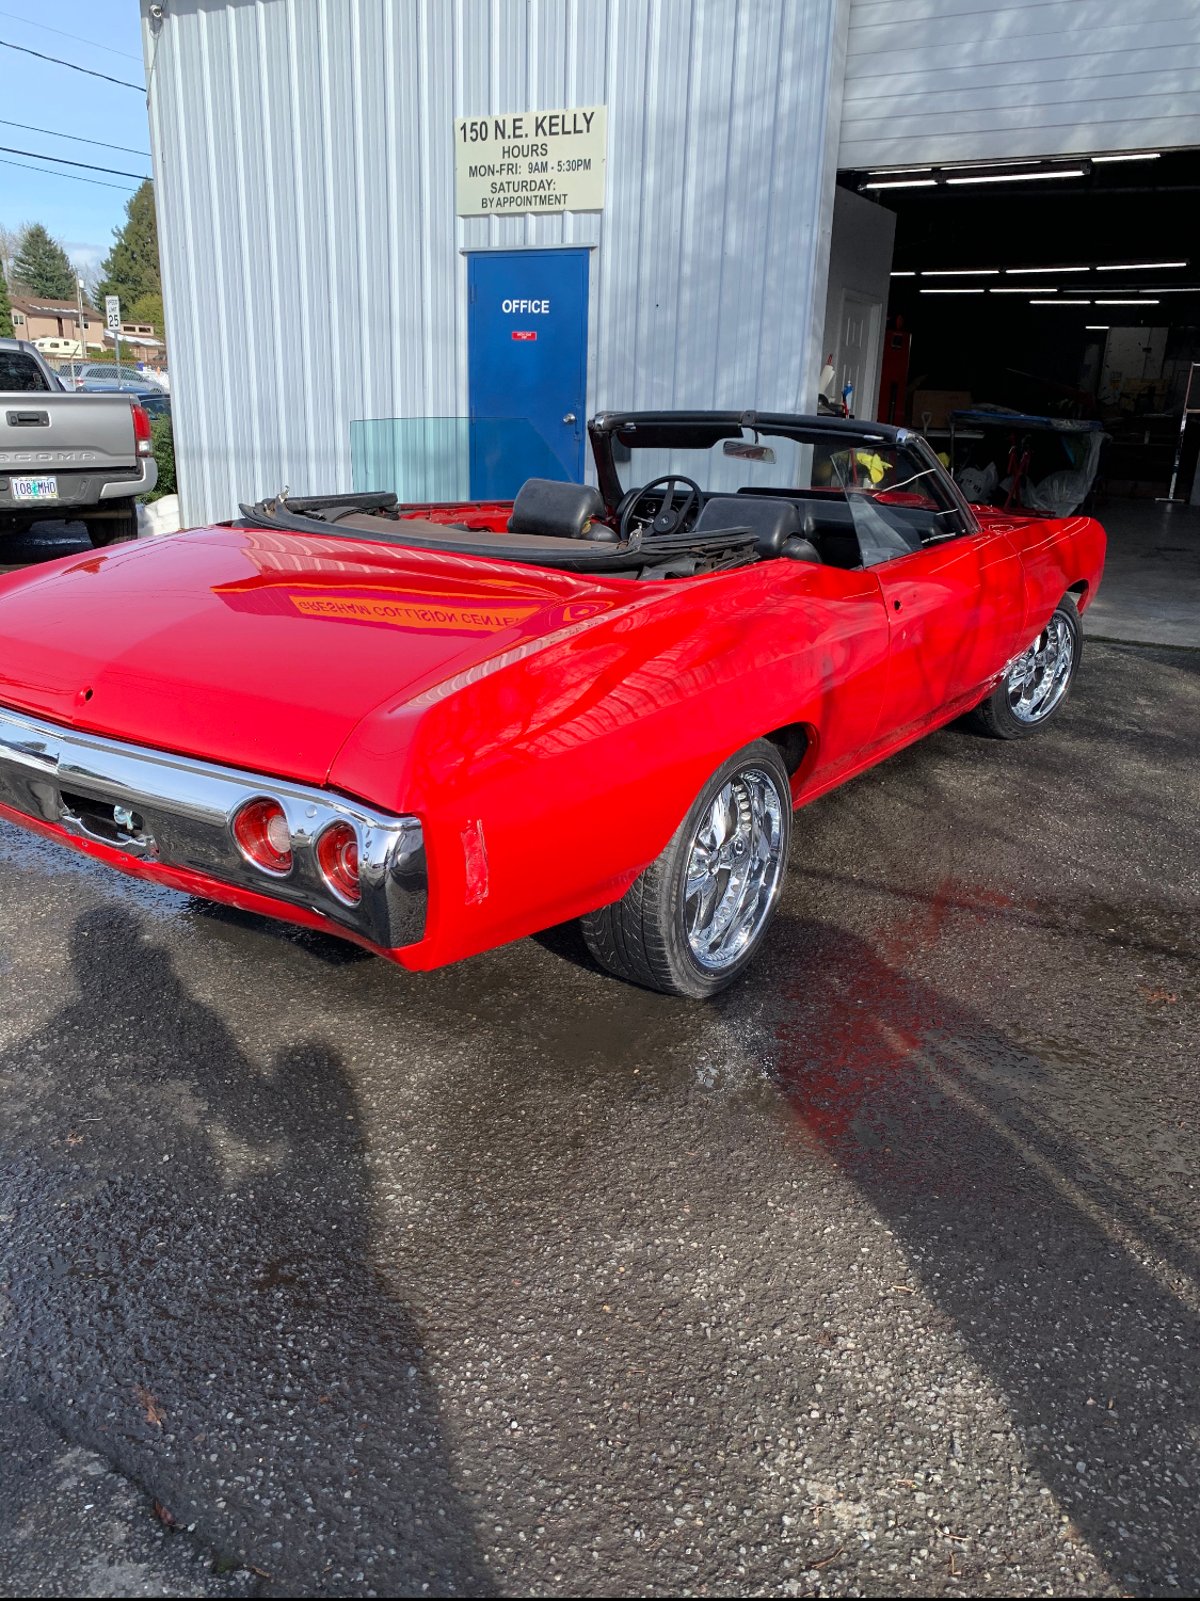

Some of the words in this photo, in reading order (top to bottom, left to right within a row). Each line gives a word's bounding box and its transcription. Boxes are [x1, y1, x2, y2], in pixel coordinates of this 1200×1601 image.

[460, 121, 488, 143] 150
[494, 117, 529, 140] N.E.
[535, 111, 595, 137] KELLY
[502, 143, 548, 159] HOURS
[468, 163, 522, 178] MON-FRI:
[528, 161, 549, 174] 9AM
[557, 158, 592, 173] 5:30PM
[490, 178, 556, 194] SATURDAY:
[481, 197, 495, 209] BY
[496, 193, 568, 208] APPOINTMENT
[502, 299, 550, 314] OFFICE
[108, 314, 119, 327] 25
